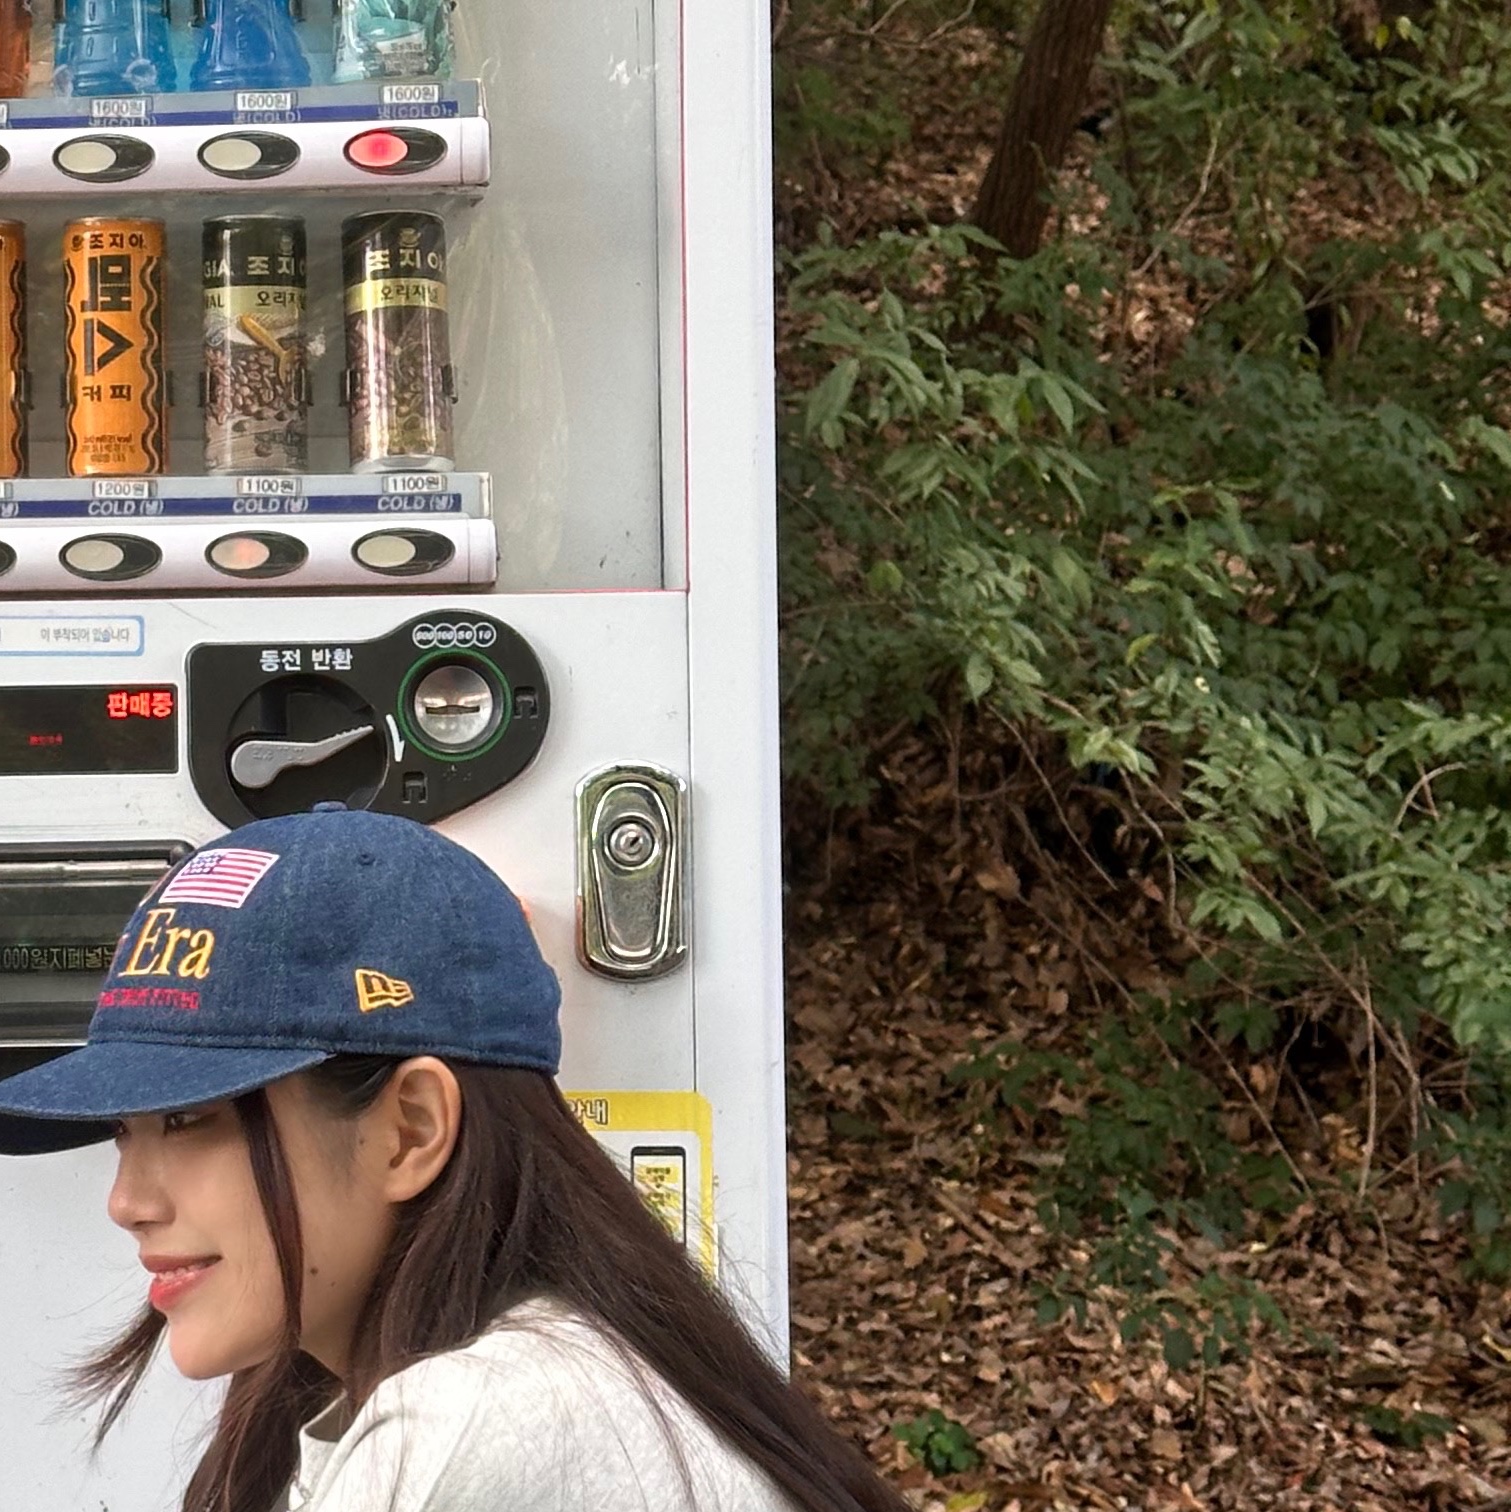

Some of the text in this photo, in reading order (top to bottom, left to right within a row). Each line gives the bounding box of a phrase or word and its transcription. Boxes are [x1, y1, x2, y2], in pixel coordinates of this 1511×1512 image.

[89, 233, 145, 250] 조지아
[366, 248, 443, 272] 조지아
[82, 384, 132, 402] 커피
[88, 501, 136, 516] COLD
[233, 498, 279, 513] COLD
[378, 496, 425, 511] COLD
[93, 627, 130, 642] 있습니다
[259, 648, 354, 672] 동전 반환
[107, 692, 174, 718] 판매중
[118, 908, 215, 979] Era
